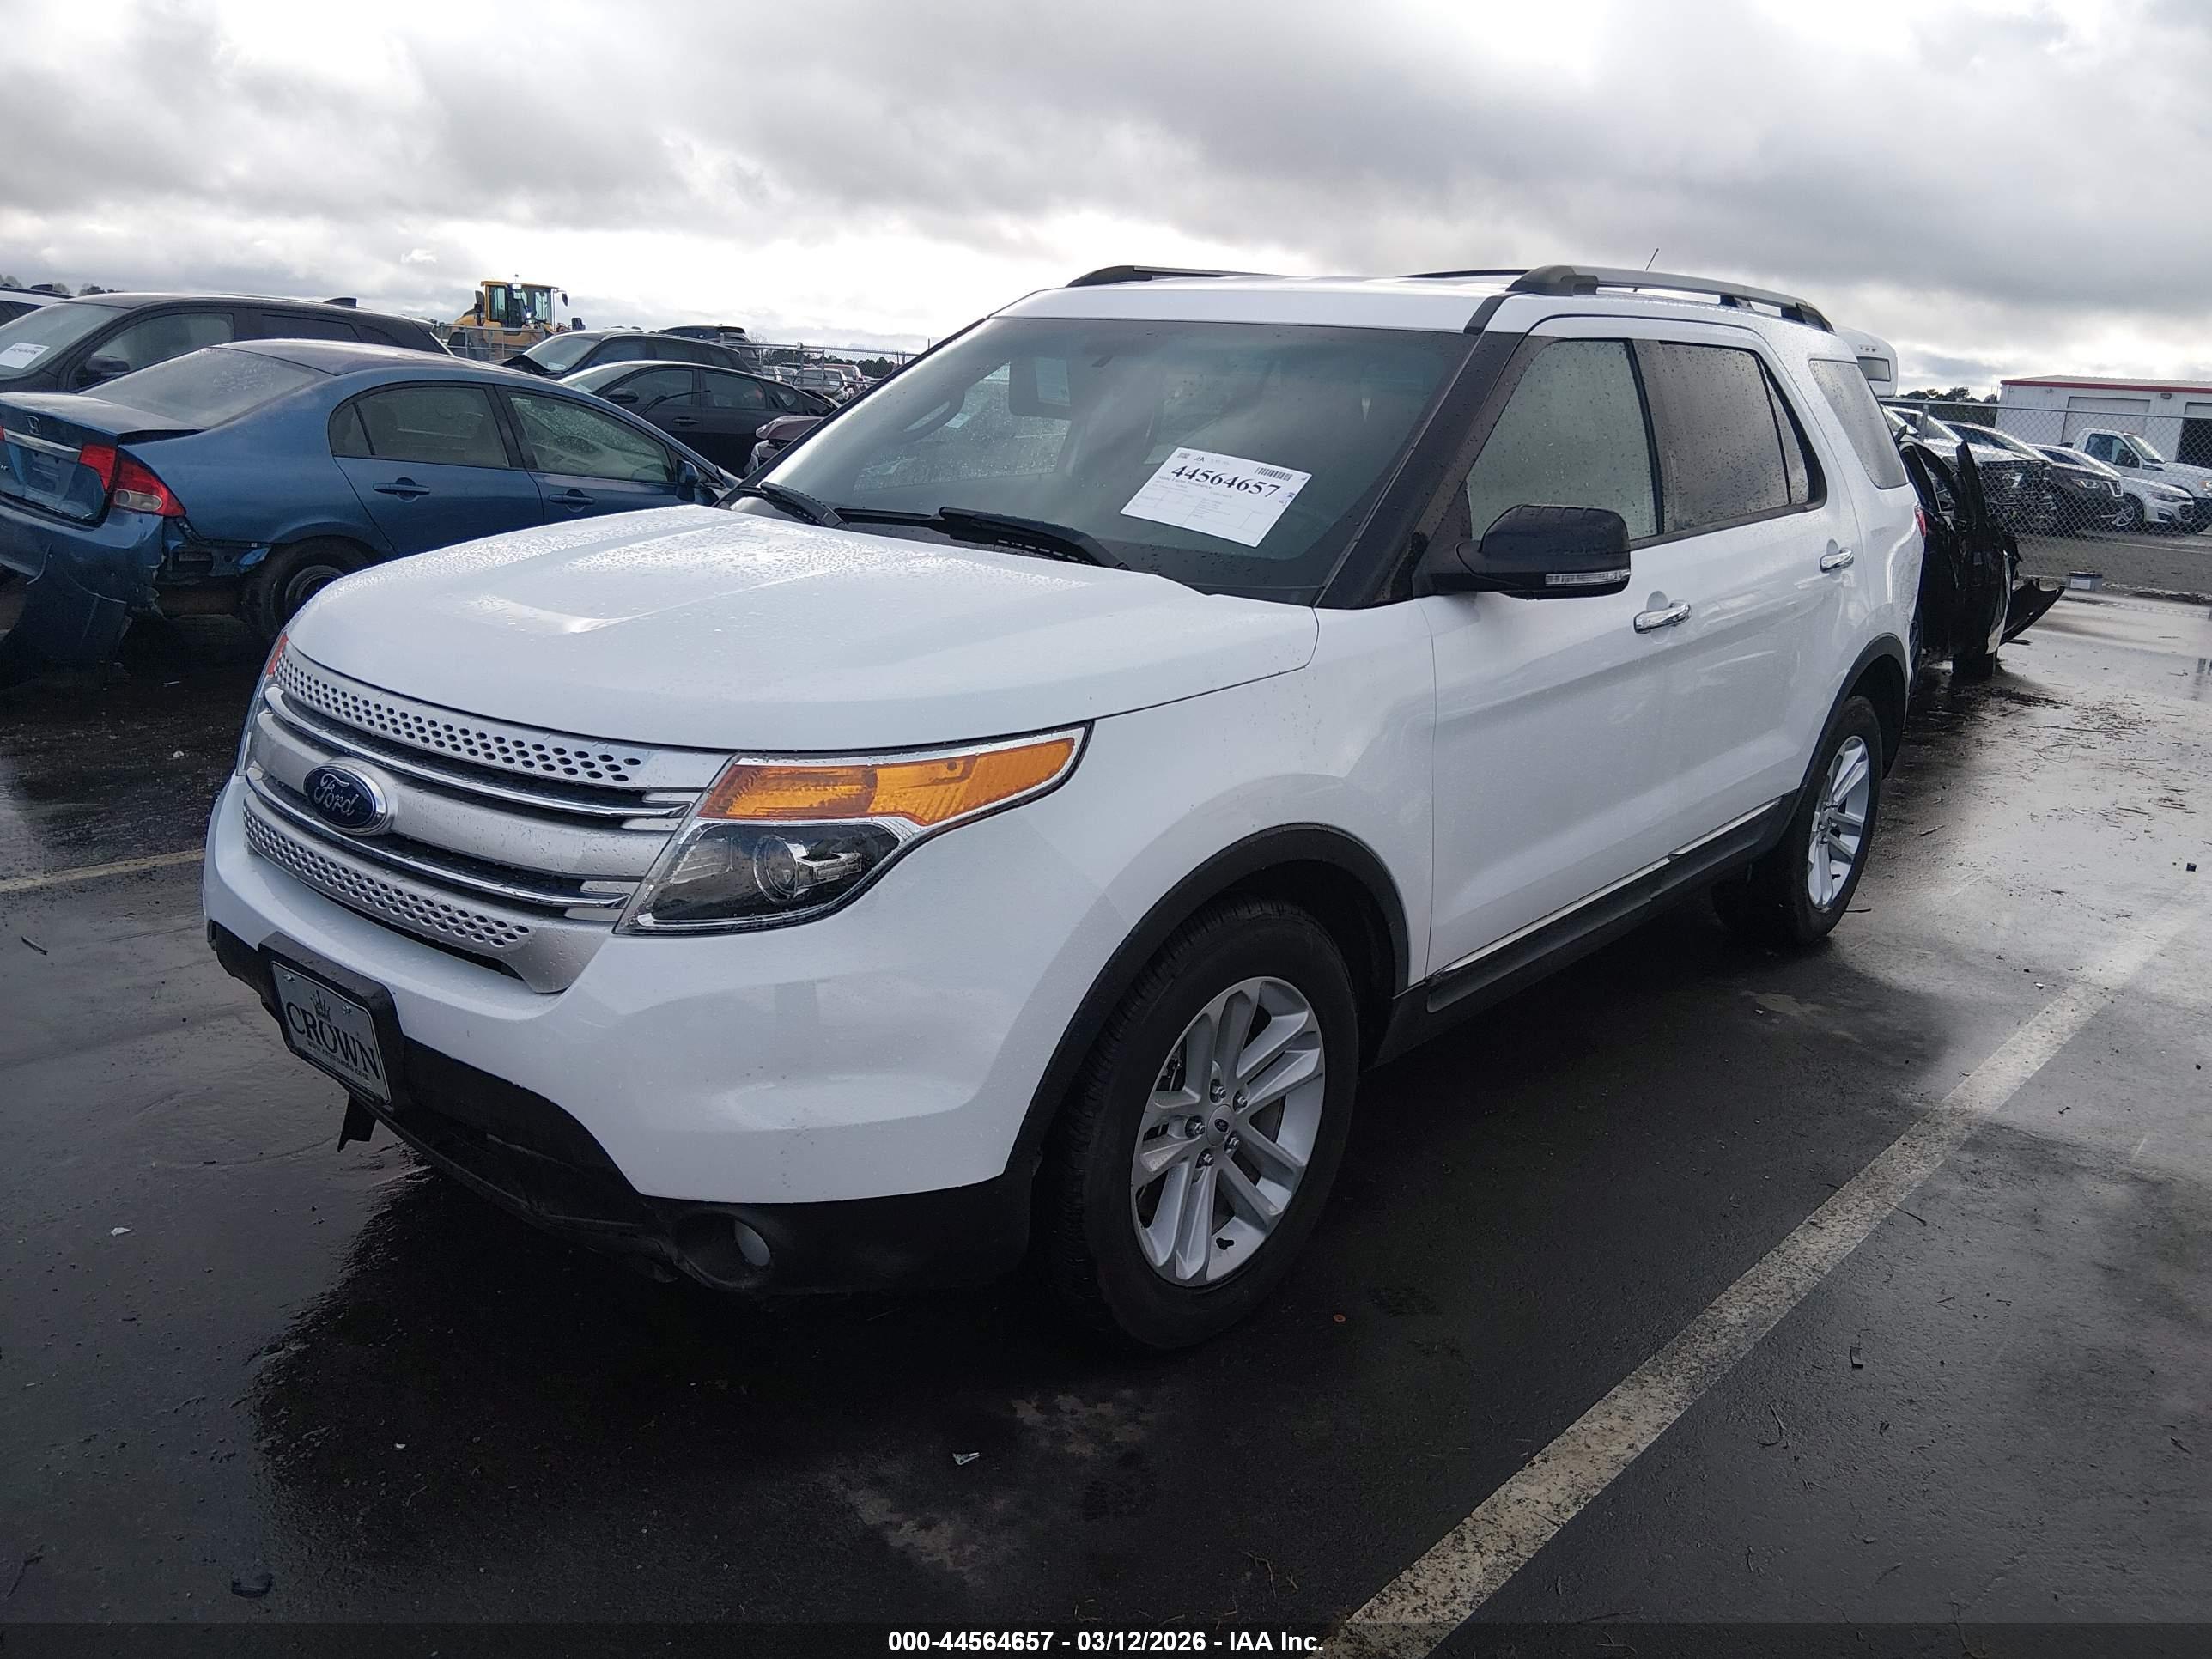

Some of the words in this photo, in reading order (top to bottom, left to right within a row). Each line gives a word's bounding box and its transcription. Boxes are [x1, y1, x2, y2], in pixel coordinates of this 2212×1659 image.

[1171, 465, 1281, 498] 44564657
[313, 773, 360, 816] Ford
[286, 1001, 380, 1080] CROWN
